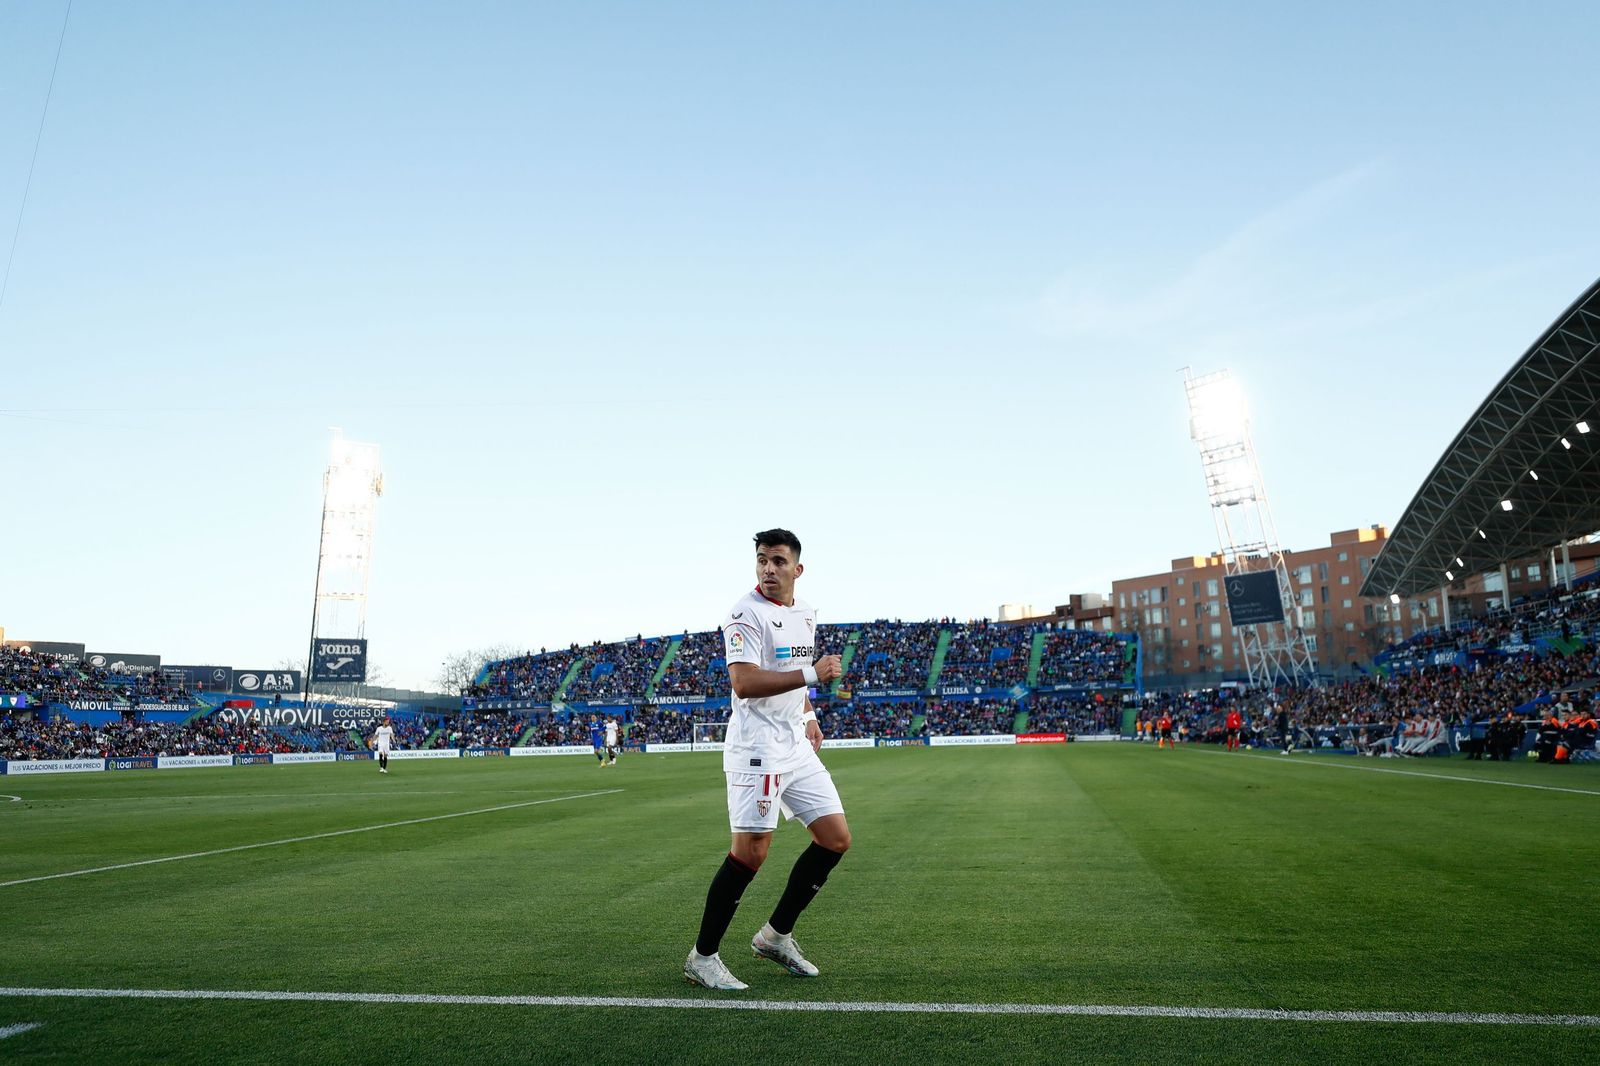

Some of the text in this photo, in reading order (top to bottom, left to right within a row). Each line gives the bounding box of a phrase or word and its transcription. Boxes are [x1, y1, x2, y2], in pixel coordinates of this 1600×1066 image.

[942, 687, 969, 695] LUJISA
[648, 696, 687, 704] YAMOVIL
[68, 701, 112, 711] YAMOVIL
[237, 708, 329, 727] YAMOVIL
[333, 708, 386, 718] COCHES DE
[22, 763, 58, 771] VACACIONES
[64, 762, 82, 770] MEJOR
[116, 761, 153, 769] LOGITRAVEL
